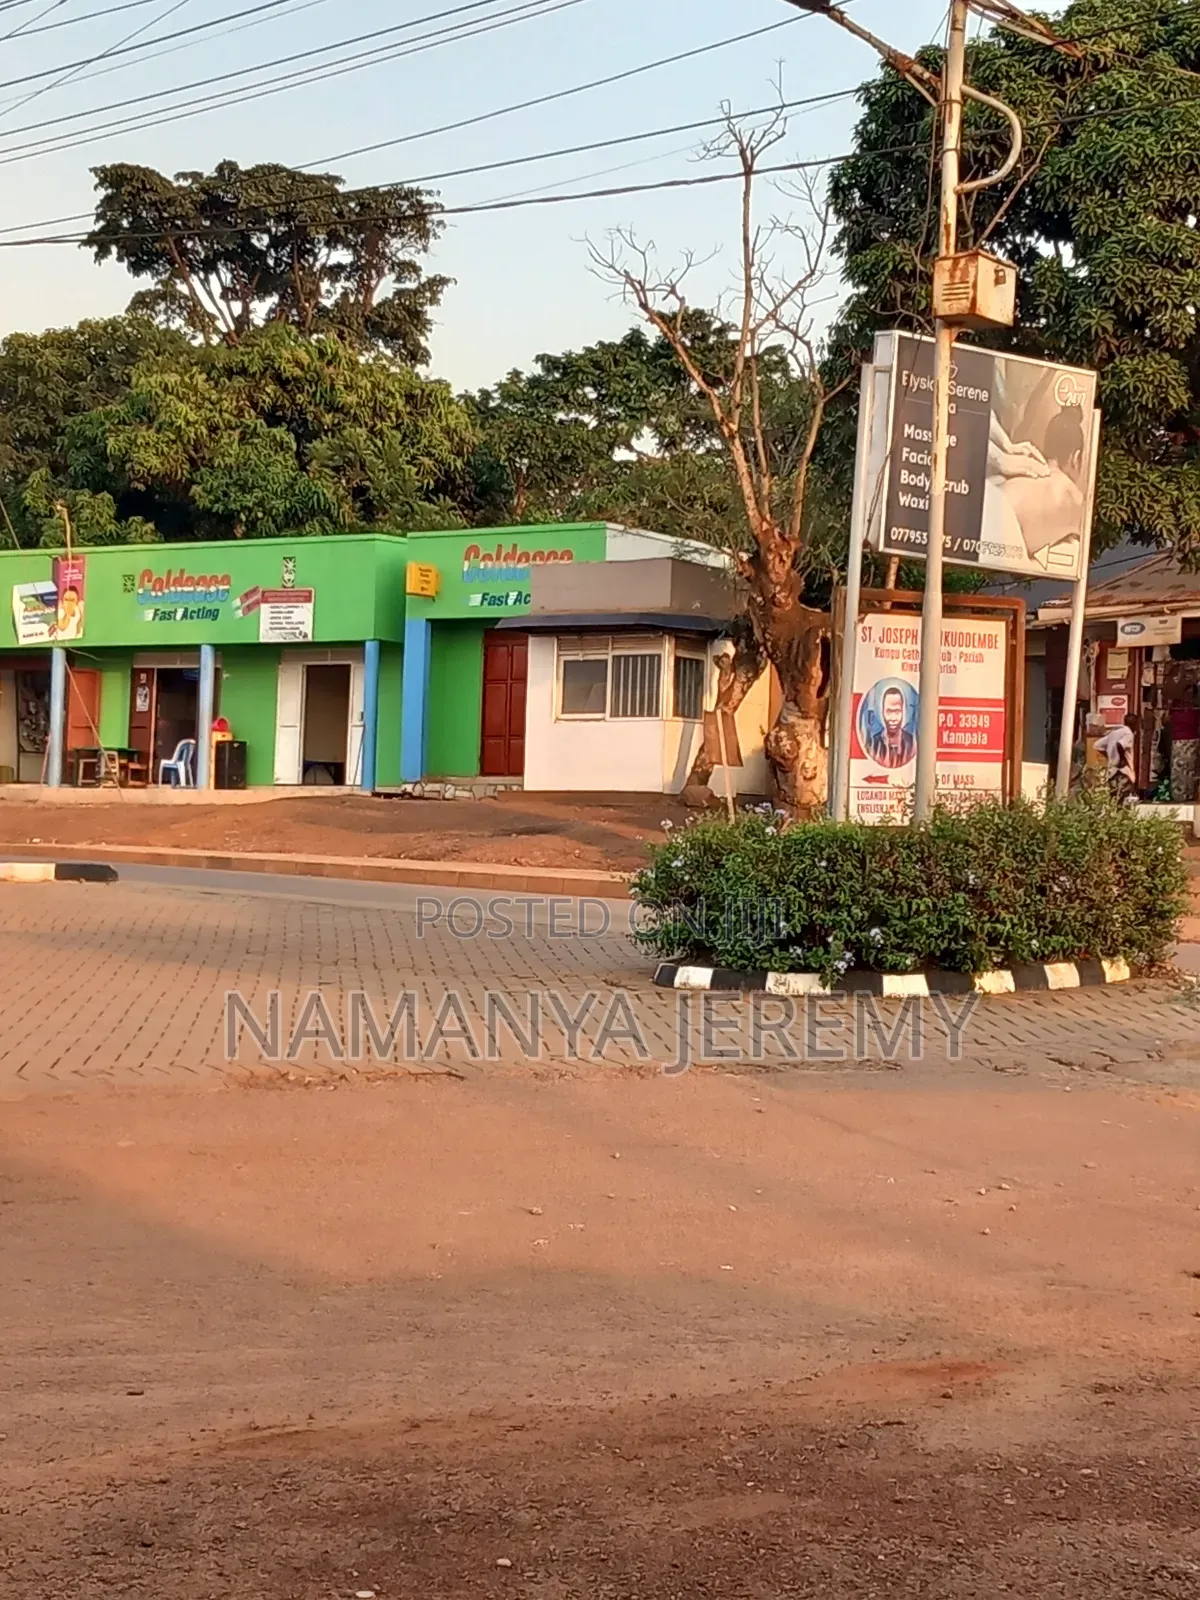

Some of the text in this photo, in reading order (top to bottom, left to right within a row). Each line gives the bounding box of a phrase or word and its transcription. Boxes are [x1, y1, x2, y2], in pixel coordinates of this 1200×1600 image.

[902, 370, 989, 402] Elysi Serene
[902, 447, 932, 466] Faci
[900, 469, 969, 495] Body crub
[898, 491, 930, 511] Waxi
[137, 567, 232, 605] Coldease
[480, 592, 510, 606] Fast
[152, 607, 220, 621] Fast Acting
[861, 626, 876, 643] ST.
[879, 627, 919, 645] JOSEPH
[959, 651, 985, 664] Parish
[939, 713, 990, 728] P.O. 33949
[942, 730, 988, 746] Kampala
[941, 774, 951, 785] OF
